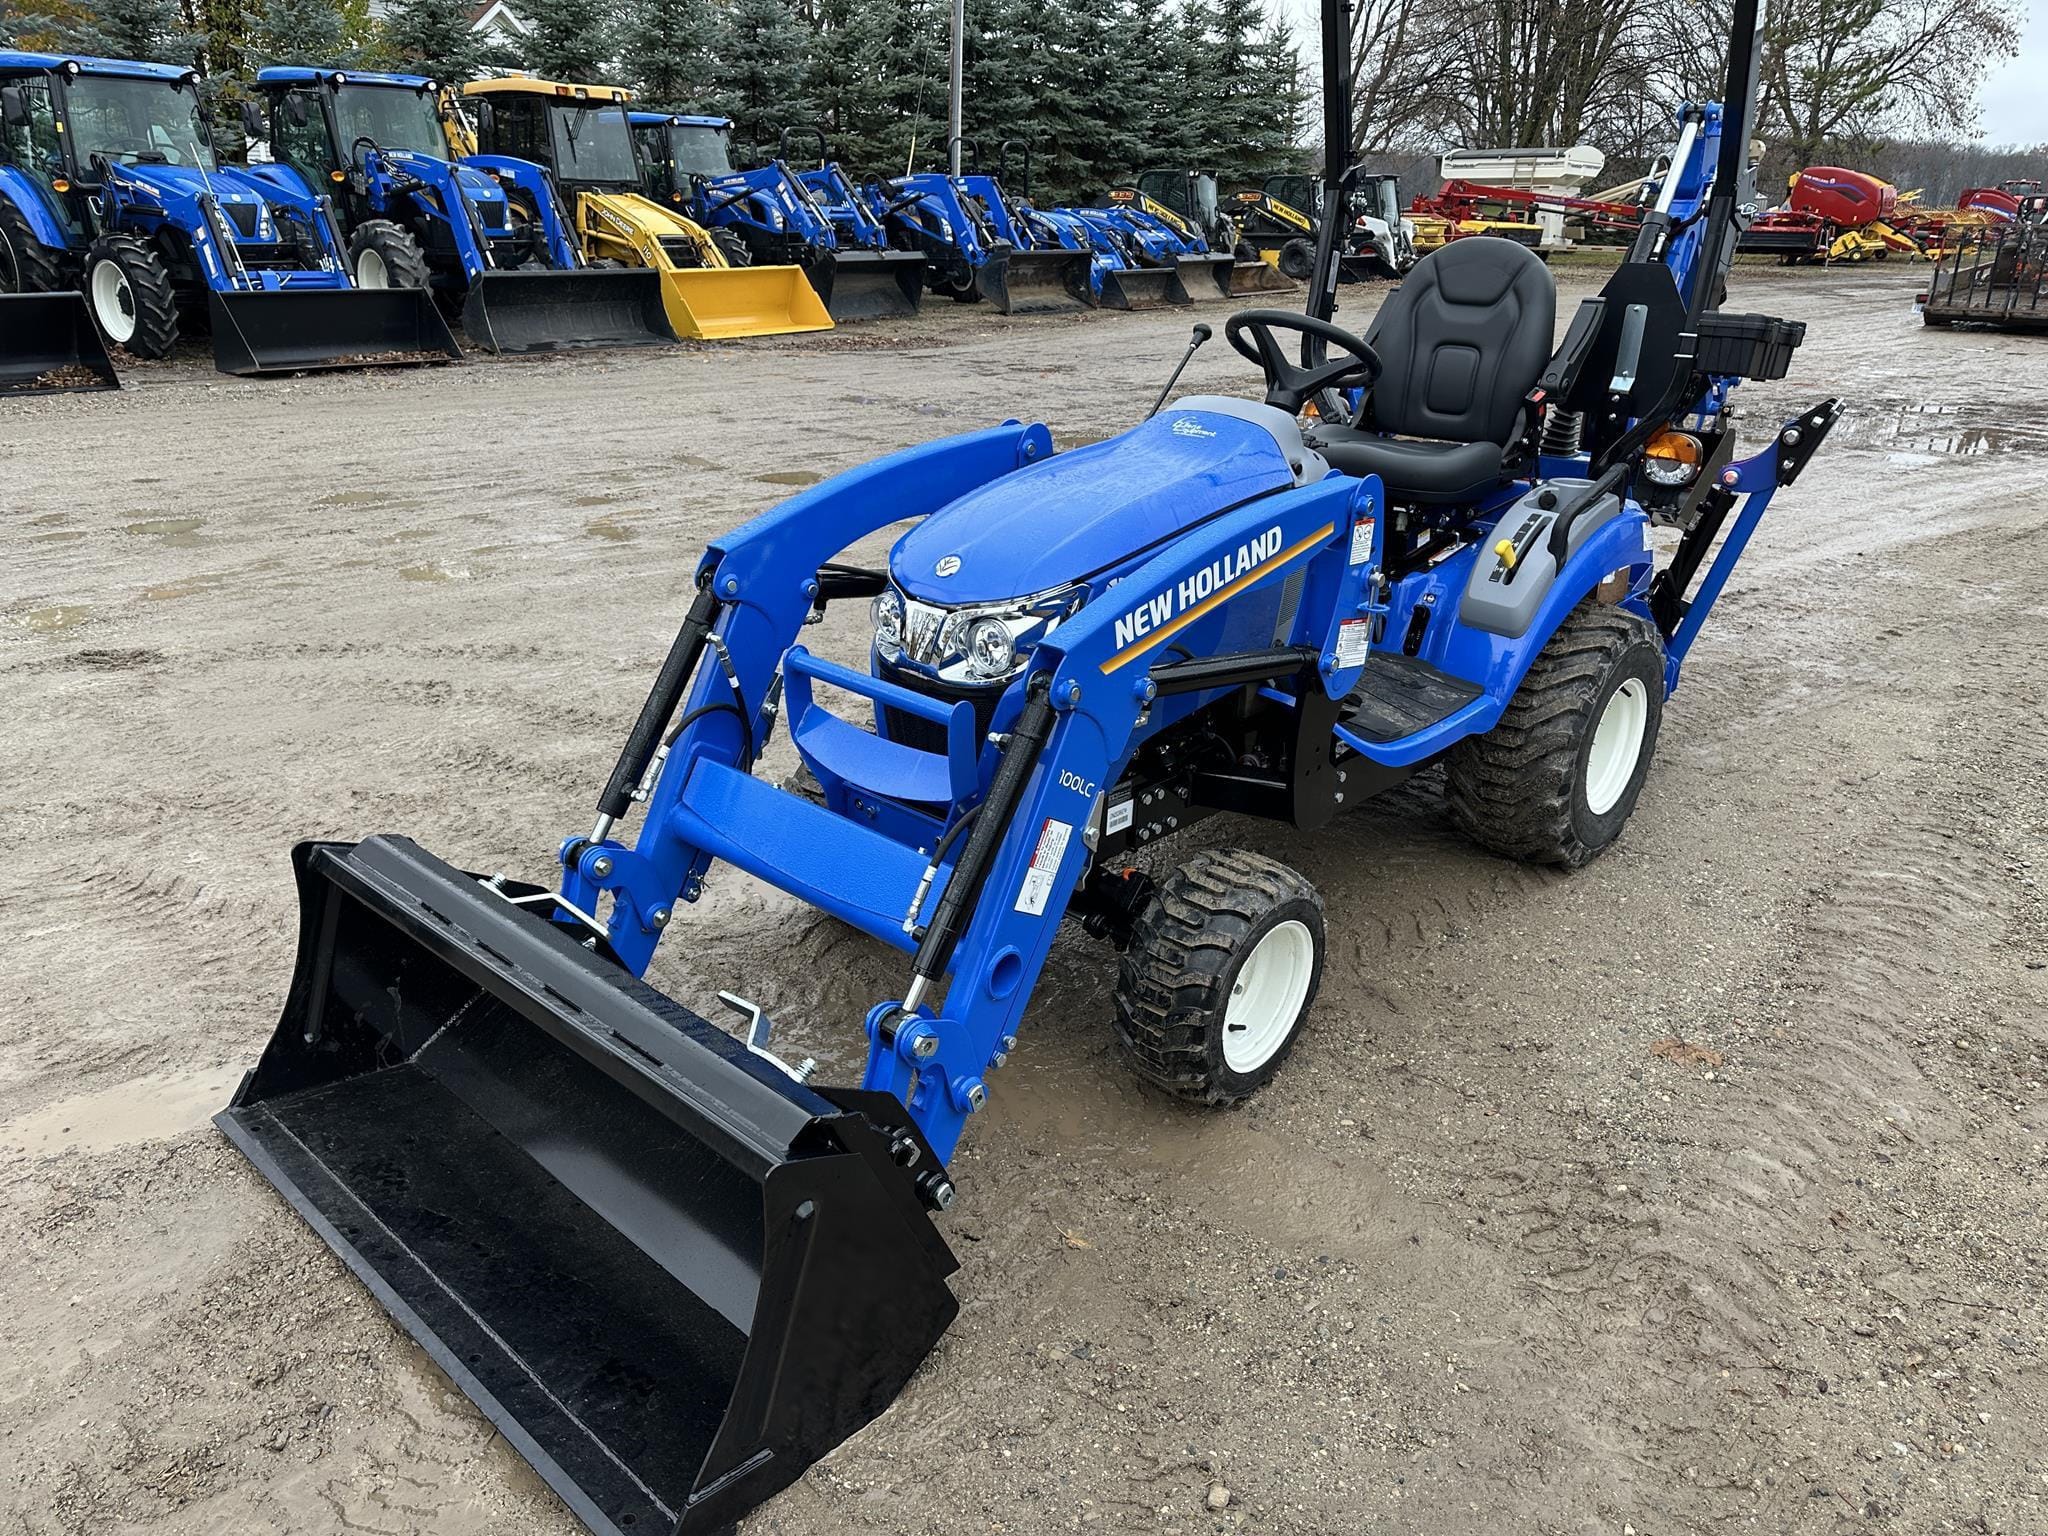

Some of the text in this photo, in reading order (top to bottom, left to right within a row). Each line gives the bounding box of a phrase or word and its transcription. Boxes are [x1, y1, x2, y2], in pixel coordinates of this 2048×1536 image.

[601, 208, 635, 235] JOHN DEERE
[642, 244, 653, 260] 110
[1115, 588, 1173, 650] NEW
[1178, 525, 1283, 611] HOLLAND
[1058, 769, 1096, 798] 100LC
